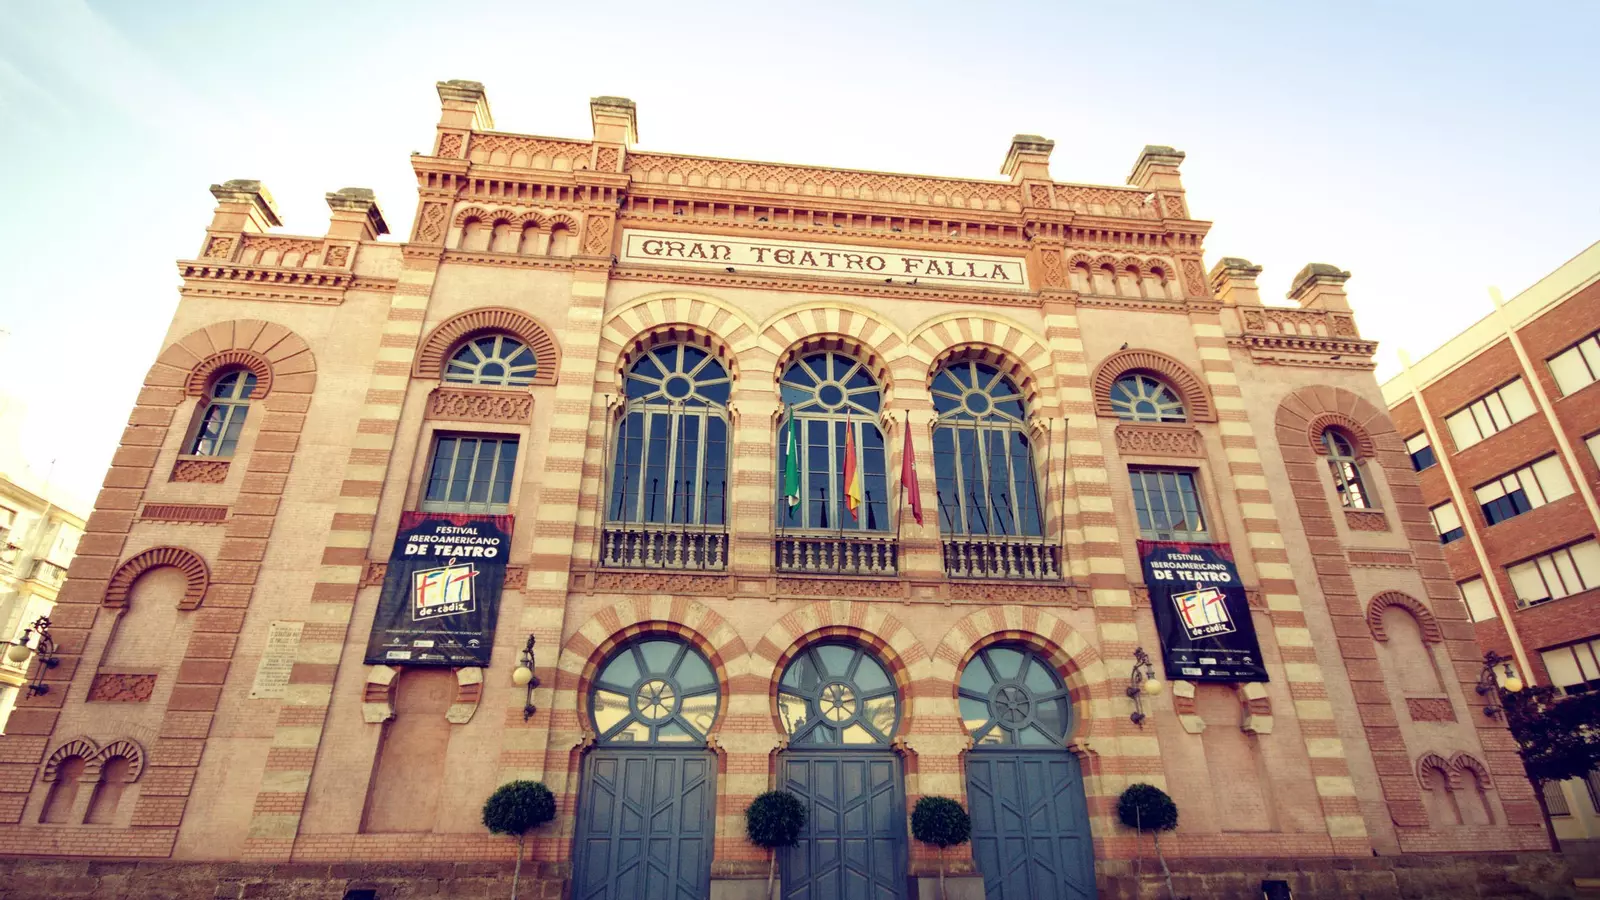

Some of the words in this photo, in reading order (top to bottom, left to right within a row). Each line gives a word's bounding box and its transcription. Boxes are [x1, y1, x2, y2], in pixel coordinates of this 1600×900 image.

[642, 239, 731, 261] GRAN
[750, 247, 886, 272] TEATRO
[901, 257, 1010, 280] FALLA
[435, 526, 478, 535] FESTIVAL
[408, 535, 500, 546] IBEROAMERICANO
[404, 544, 429, 556] DE
[434, 545, 498, 558] TEATRO
[1167, 553, 1204, 561] FESTIVAL
[1150, 561, 1226, 571] IBEROAMERICANO
[1153, 570, 1174, 580] DE
[1179, 571, 1232, 582] TEATRO
